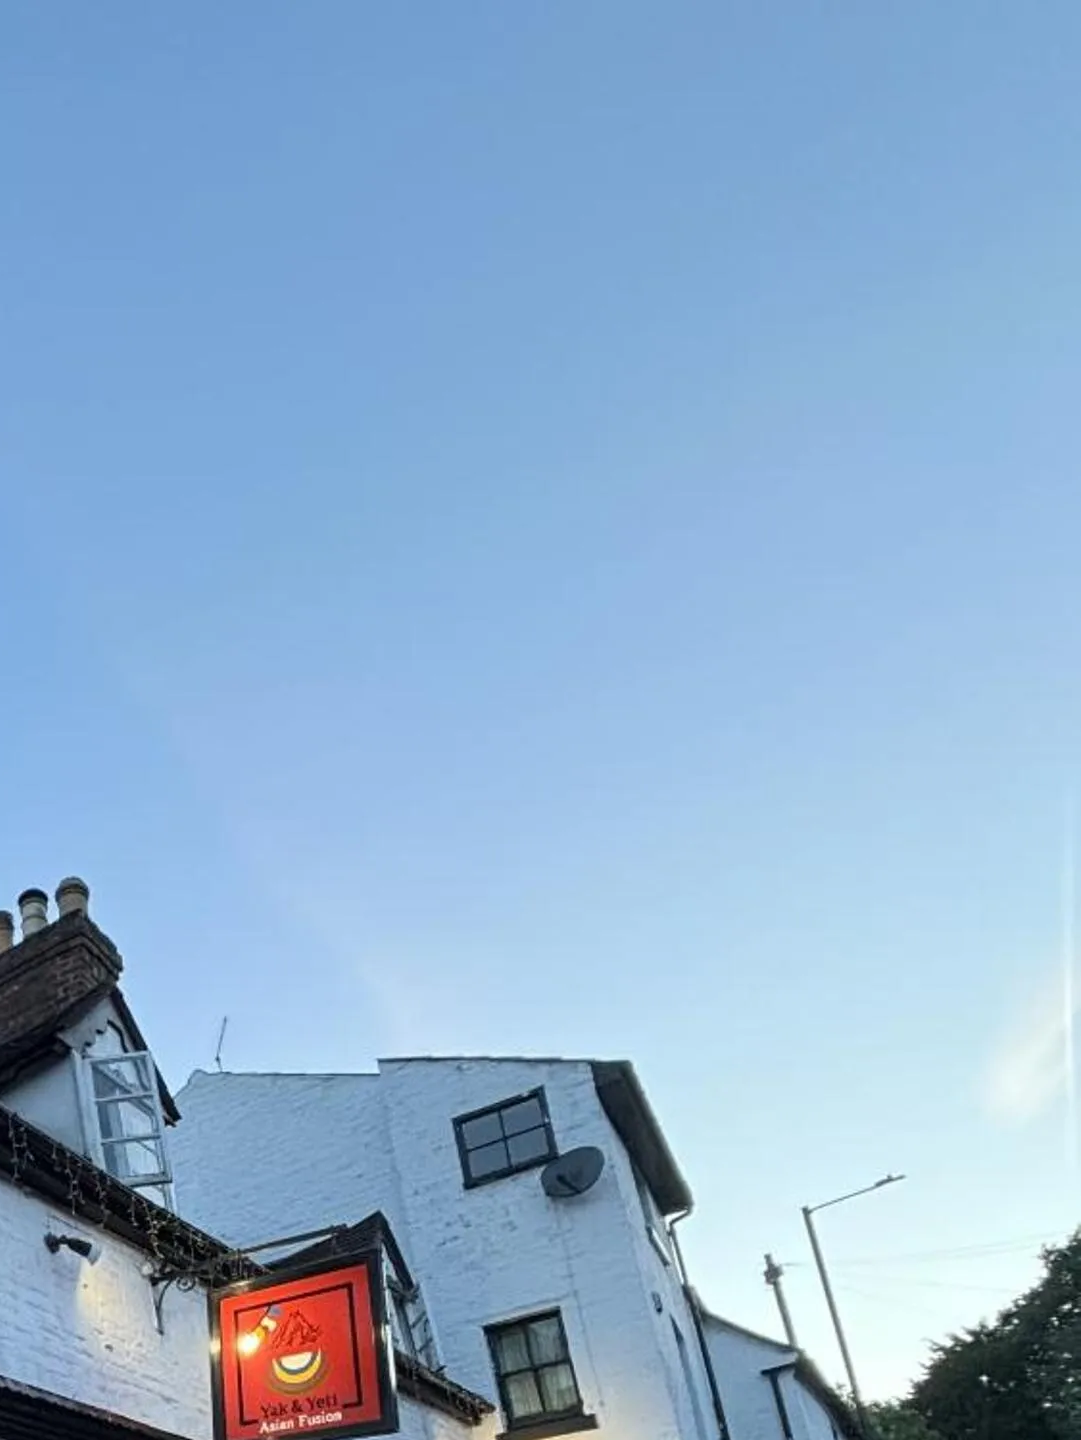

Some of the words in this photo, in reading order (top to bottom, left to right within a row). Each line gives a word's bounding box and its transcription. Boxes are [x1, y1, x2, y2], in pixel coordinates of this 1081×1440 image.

[261, 1402, 288, 1419] Yak
[291, 1399, 303, 1413] &
[259, 1418, 294, 1434] Asian
[298, 1410, 342, 1428] Fusion
